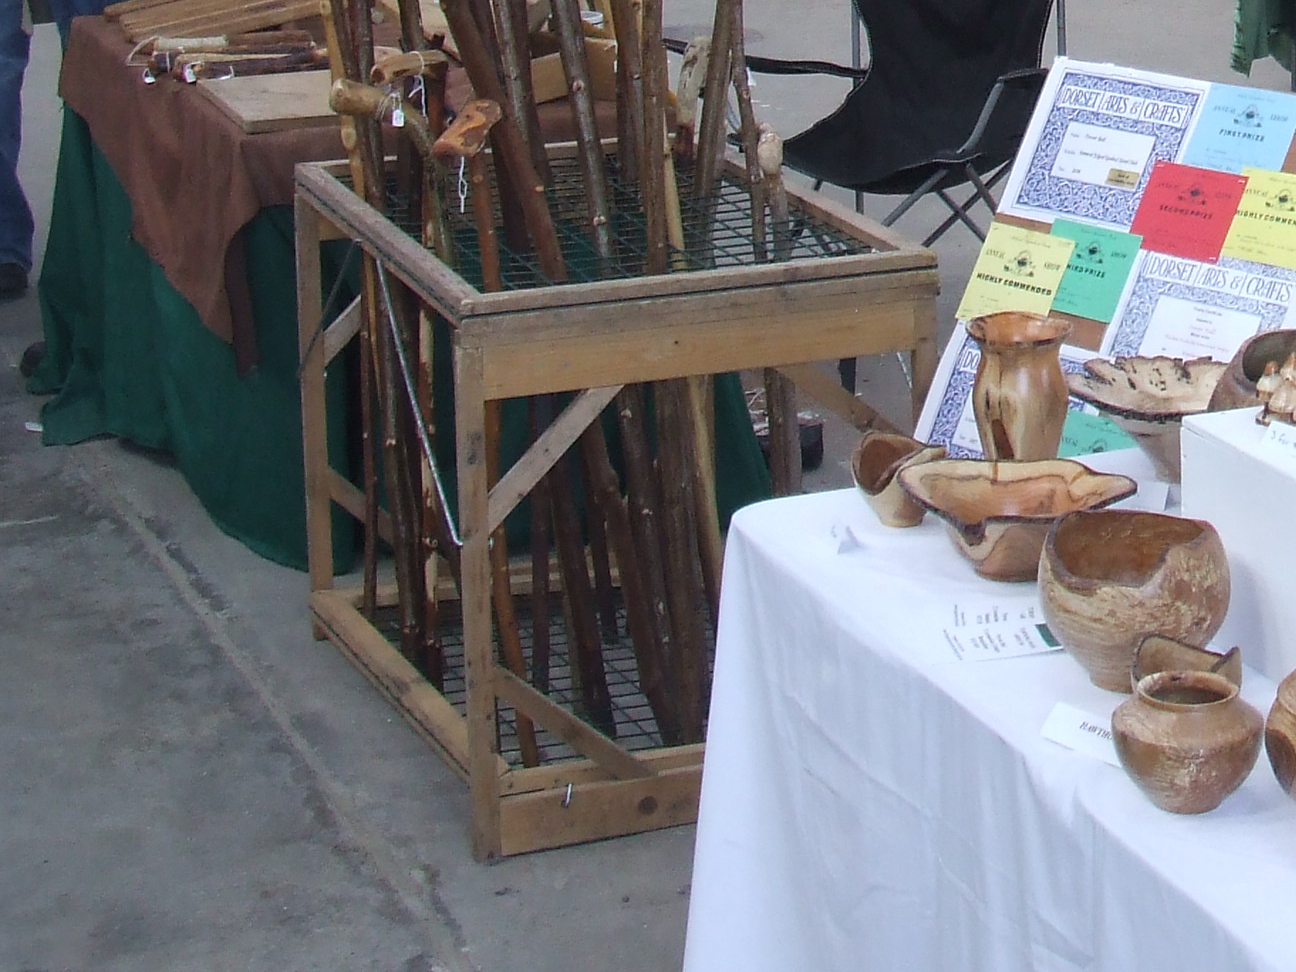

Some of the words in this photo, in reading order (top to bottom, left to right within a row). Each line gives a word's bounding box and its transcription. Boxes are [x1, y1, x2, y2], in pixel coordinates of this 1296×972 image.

[1062, 87, 1101, 108] DORSET
[1101, 95, 1130, 114] ARTS
[1130, 102, 1139, 115] &
[1219, 129, 1241, 137] FIRST
[1243, 133, 1265, 142] PRIZE
[1067, 263, 1086, 274] HIRD
[1087, 267, 1106, 278] PRIZE
[1150, 256, 1197, 280] DORSET
[1199, 267, 1229, 289] ARTS
[1230, 277, 1241, 290] &
[1246, 277, 1292, 302] CRAFTS
[976, 273, 1003, 284] HIGHLY
[1003, 278, 1052, 296] COMMENDED
